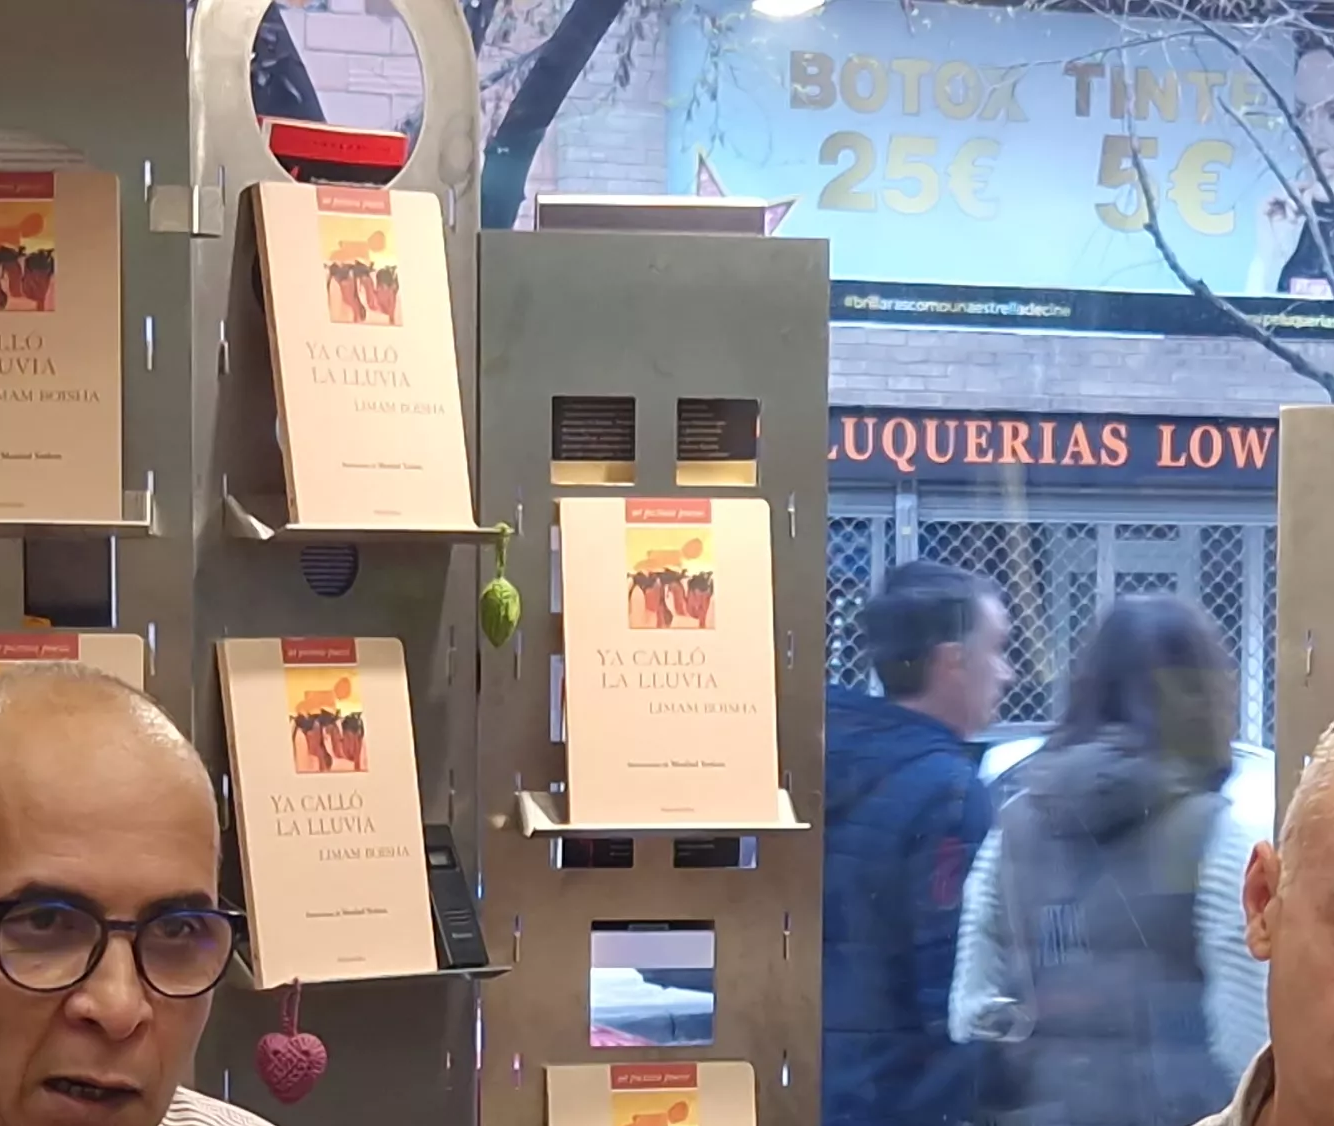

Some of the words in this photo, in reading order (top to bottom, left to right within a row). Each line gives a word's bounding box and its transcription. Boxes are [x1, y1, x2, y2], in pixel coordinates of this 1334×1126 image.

[789, 49, 1029, 123] BOTOX
[817, 130, 1001, 222] 25€
[1094, 132, 1236, 237] 5€
[827, 416, 1130, 472] UQUERIAS
[1156, 422, 1275, 470] LOW
[596, 649, 624, 666] YA
[632, 646, 706, 667] CALLÓ
[602, 673, 628, 689] LA
[639, 673, 718, 689] LLUVIA
[270, 795, 295, 814] YA
[301, 789, 364, 812] CALLÓ
[276, 819, 301, 837] LA
[308, 816, 376, 836] LLUVIA
